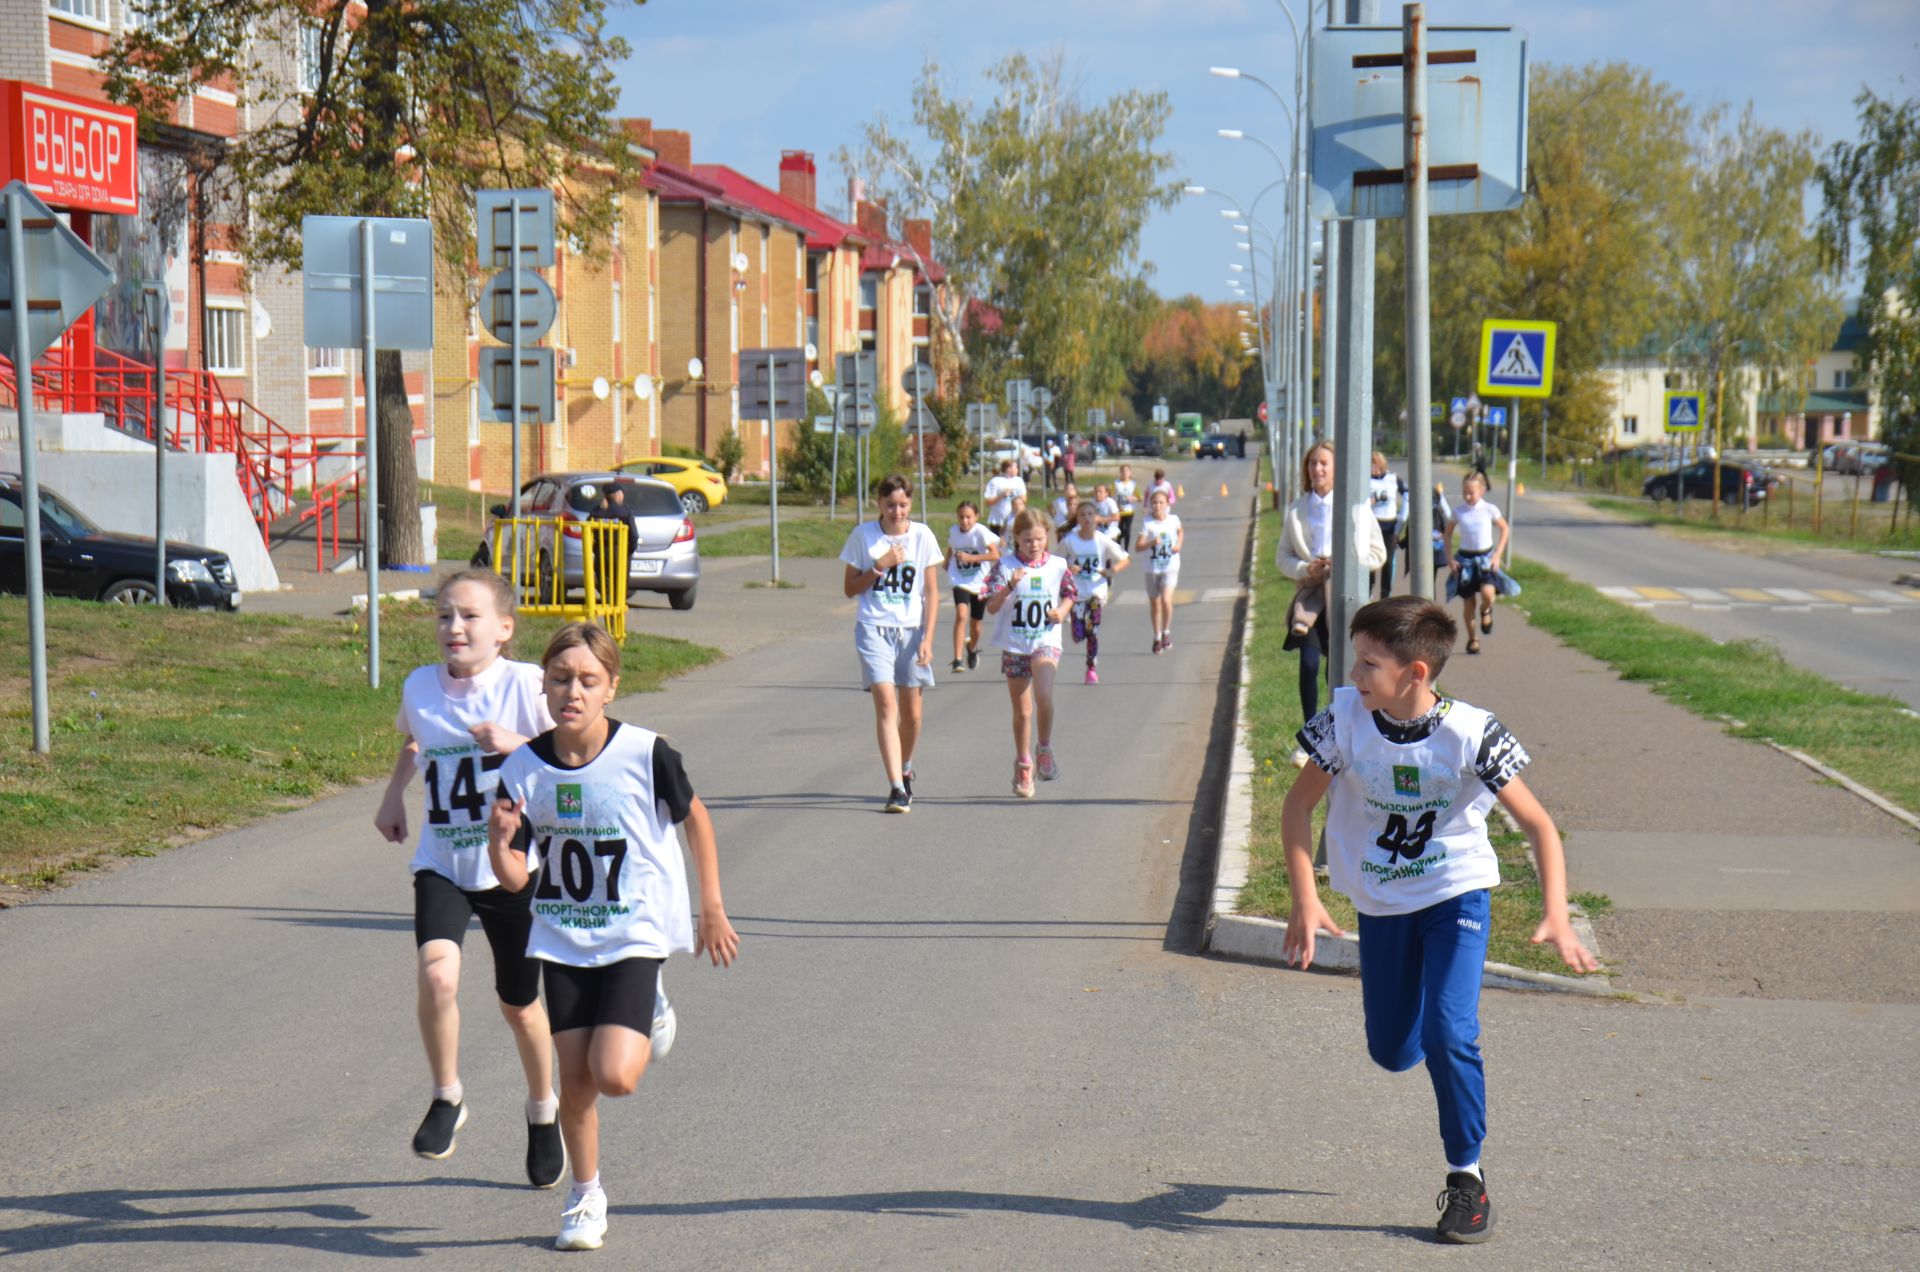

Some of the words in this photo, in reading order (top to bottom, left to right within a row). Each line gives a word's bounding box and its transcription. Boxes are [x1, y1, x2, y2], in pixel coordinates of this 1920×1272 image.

[33, 107, 120, 183] ВЫБОР
[586, 824, 620, 836] РАЙОН
[560, 916, 607, 929] ЖИЗНИ
